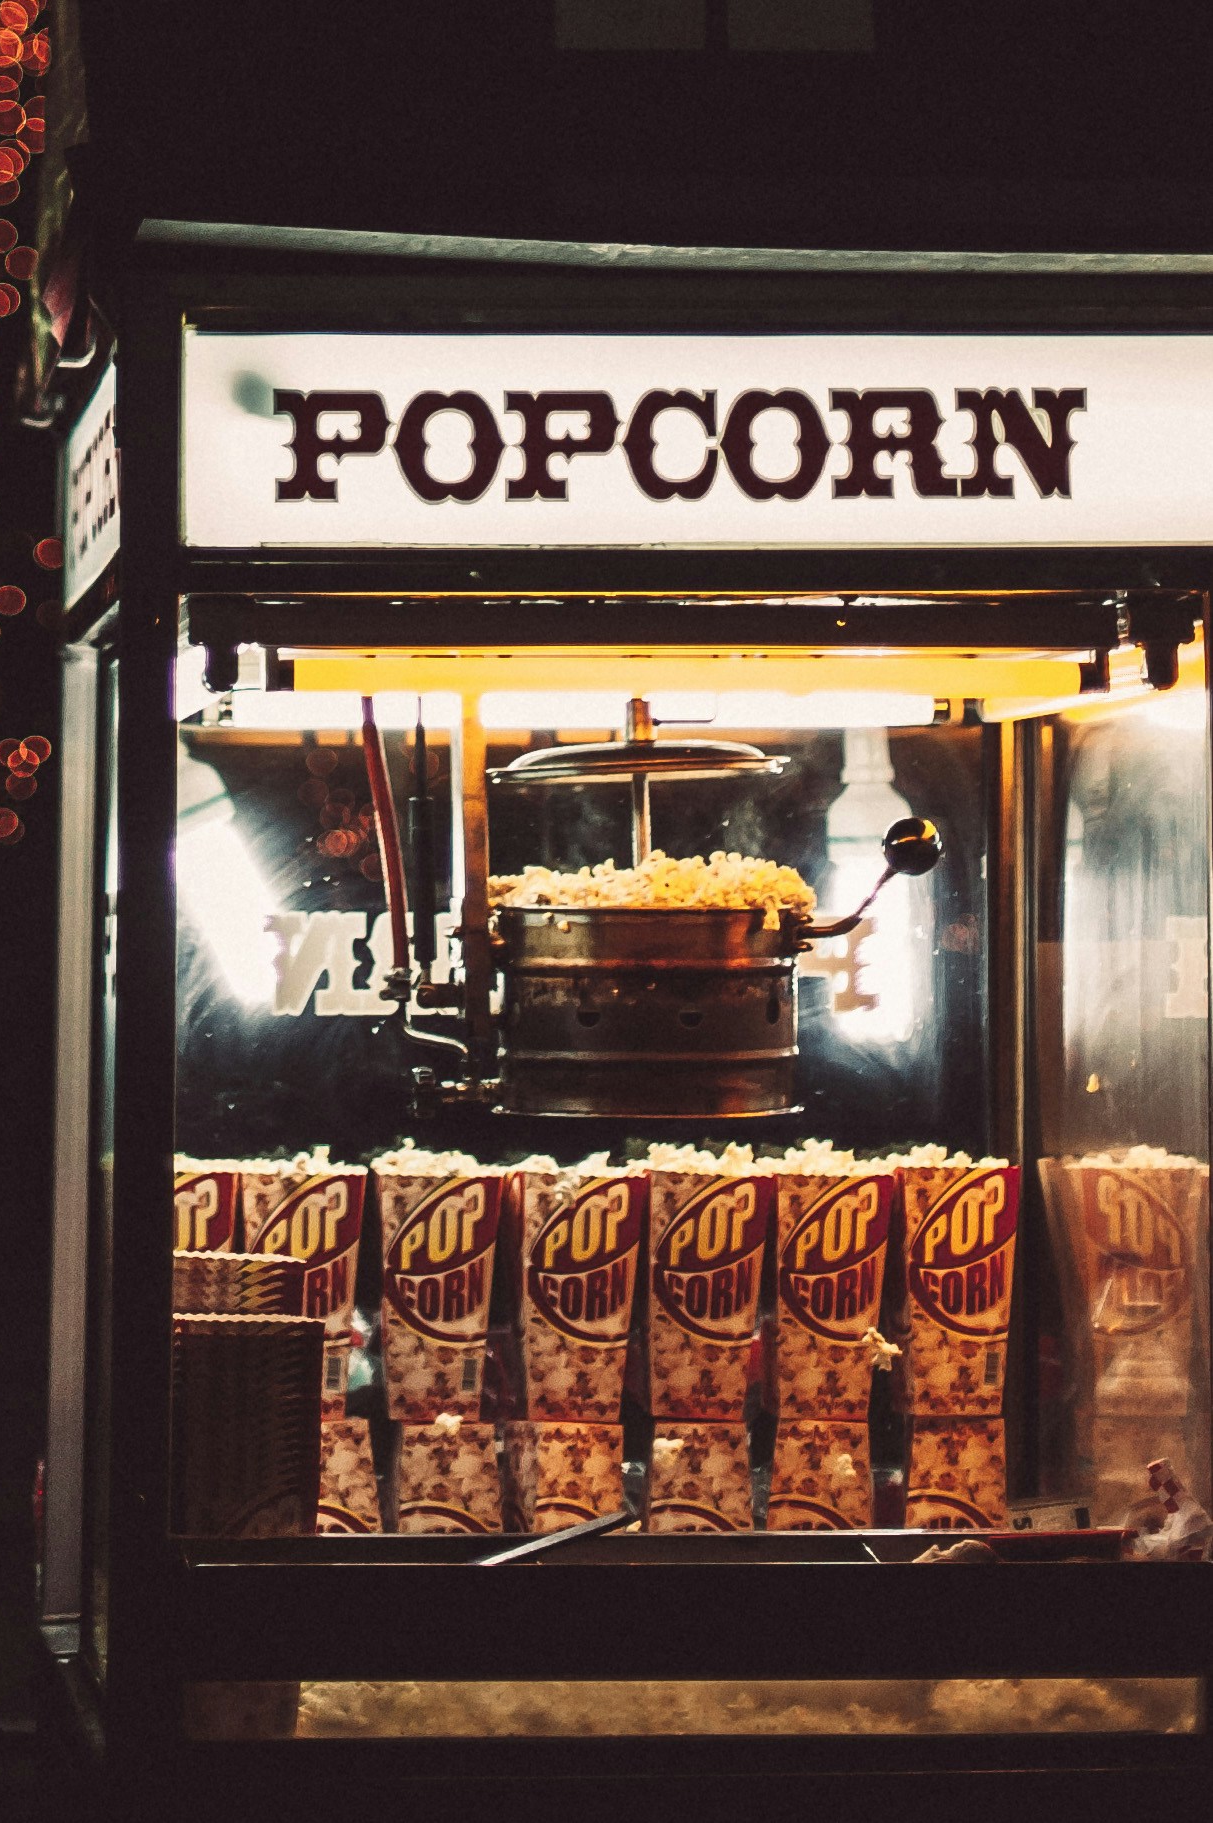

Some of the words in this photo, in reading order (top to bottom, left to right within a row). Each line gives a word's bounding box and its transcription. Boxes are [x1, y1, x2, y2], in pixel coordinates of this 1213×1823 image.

[273, 386, 1087, 504] POPCORN
[174, 1179, 218, 1252] OP
[264, 1181, 348, 1260] POP
[399, 1182, 485, 1270] POP
[543, 1182, 630, 1269] POP
[669, 1182, 756, 1267] POP
[795, 1181, 878, 1269] POP
[924, 1175, 1005, 1263] POP
[306, 1256, 348, 1318] RN
[398, 1257, 484, 1322] CORN
[542, 1257, 628, 1322] CORN
[666, 1256, 753, 1321] CORN
[793, 1256, 877, 1321] CORN
[922, 1249, 1005, 1316] CORN
